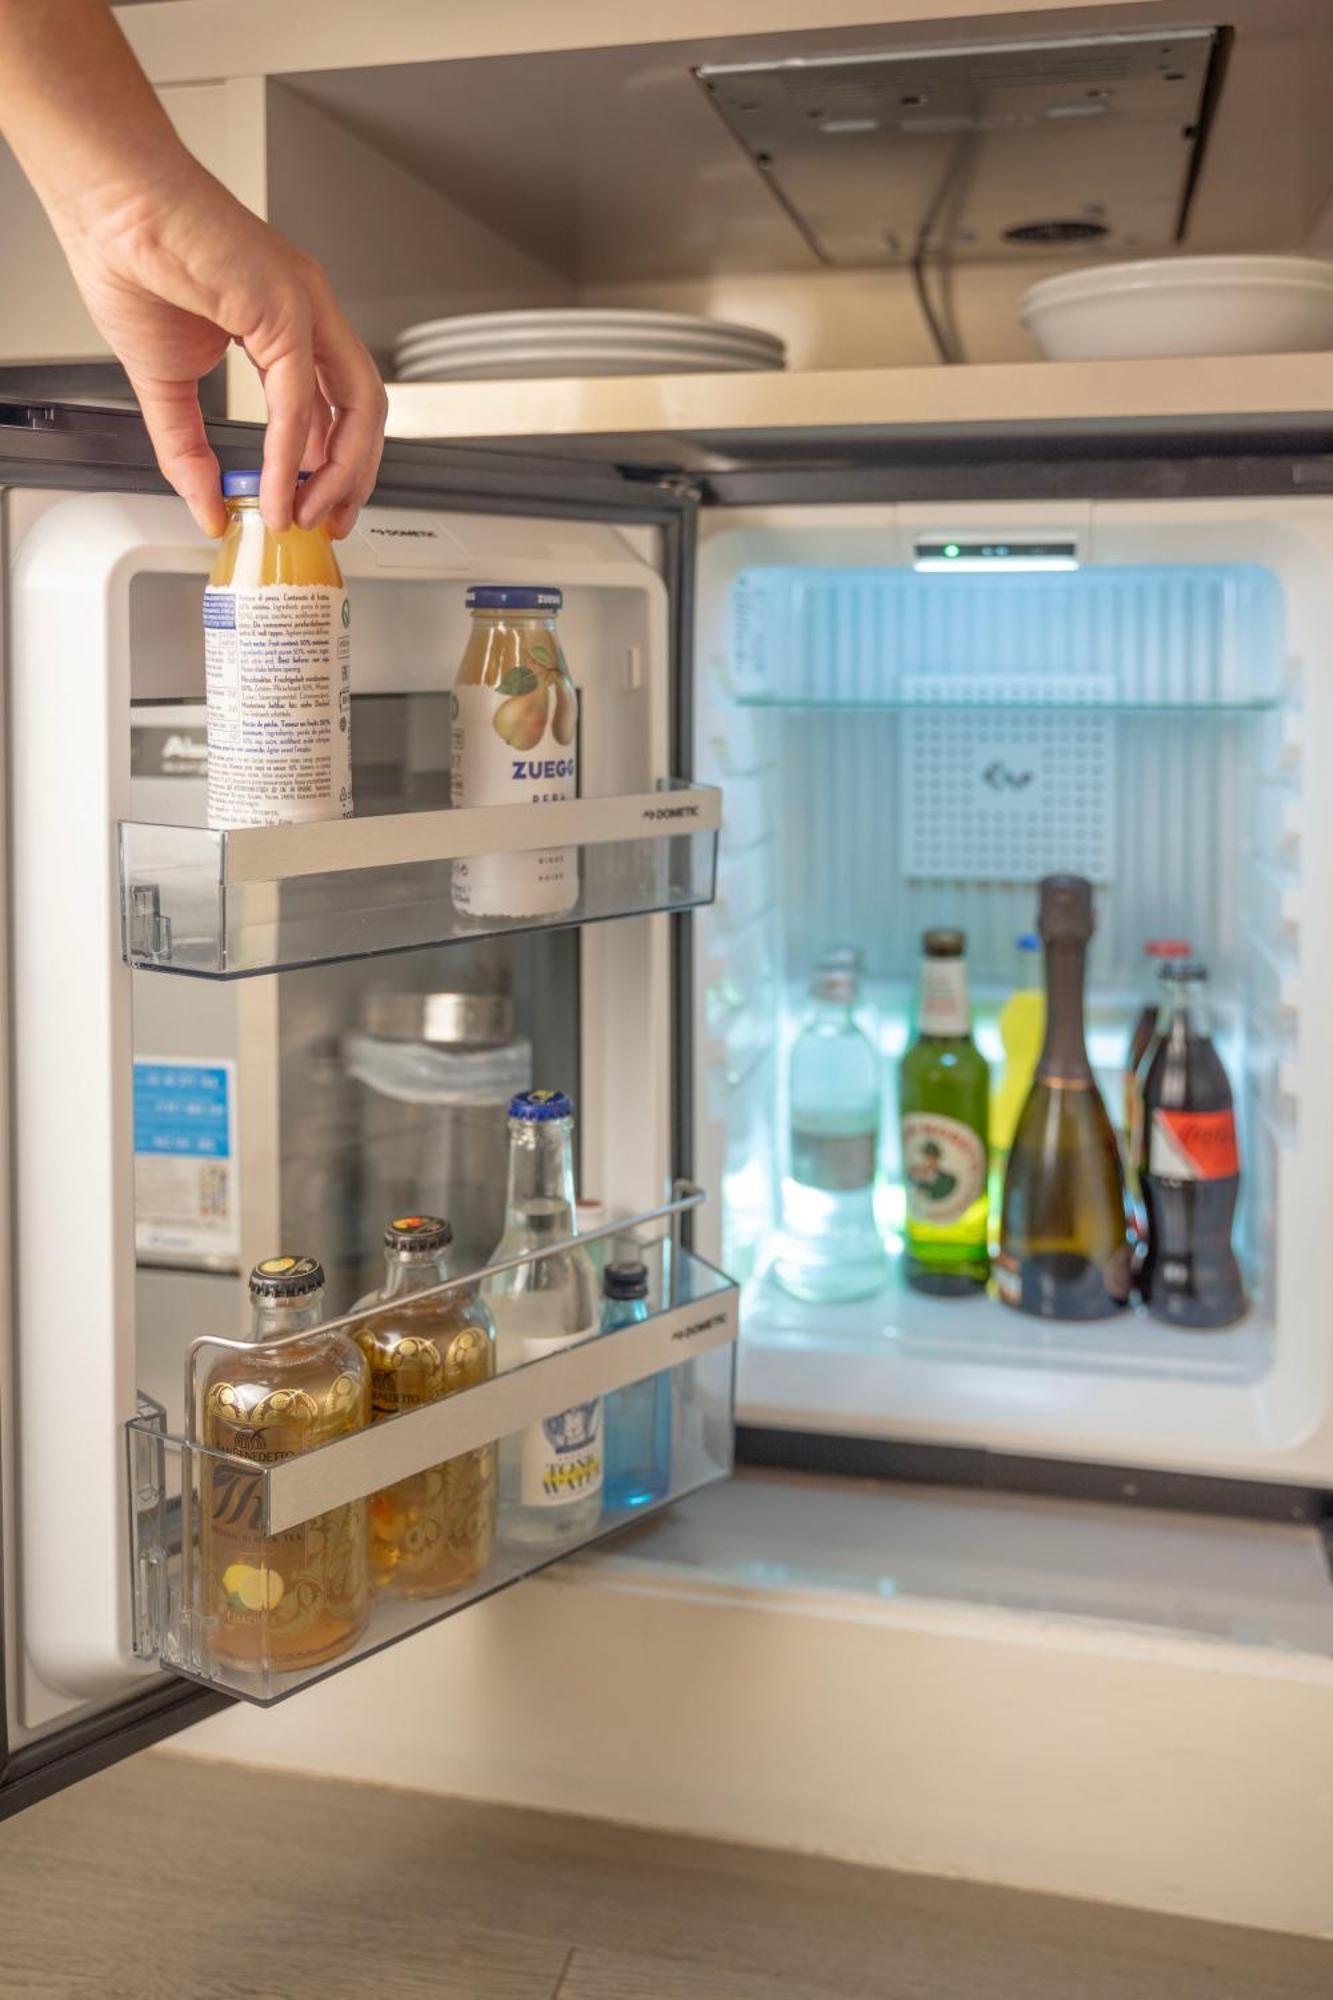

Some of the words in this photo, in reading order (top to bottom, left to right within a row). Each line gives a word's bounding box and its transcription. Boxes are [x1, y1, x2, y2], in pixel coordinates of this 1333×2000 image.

[384, 528, 438, 539] DOMETIC
[511, 758, 576, 780] ZUEGG
[656, 805, 700, 819] DOMETIC
